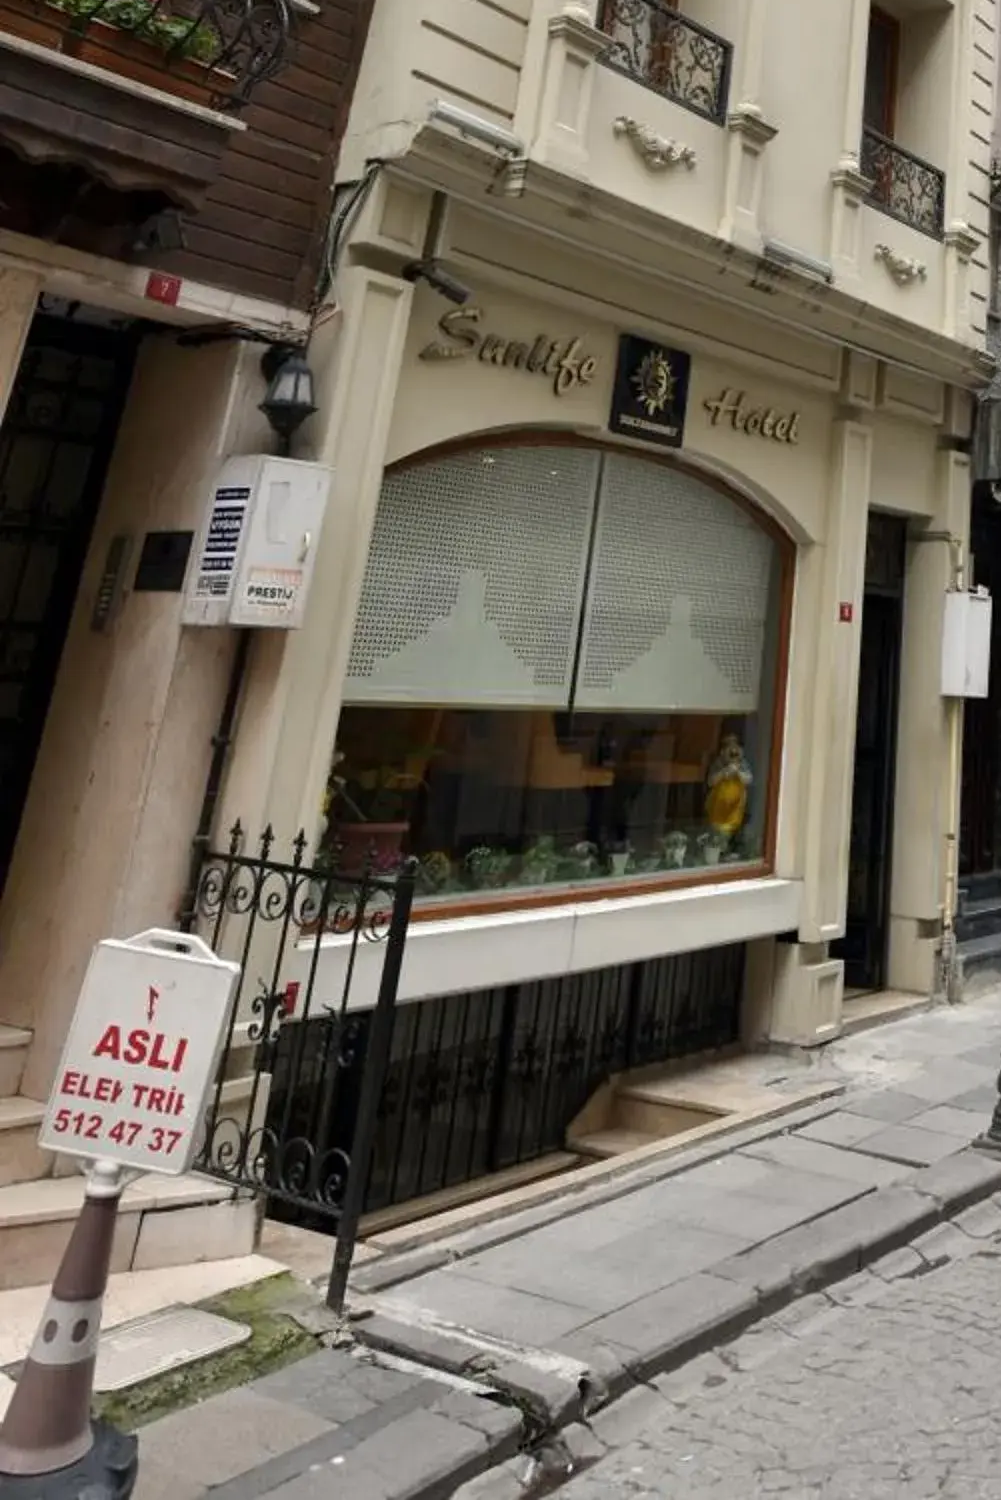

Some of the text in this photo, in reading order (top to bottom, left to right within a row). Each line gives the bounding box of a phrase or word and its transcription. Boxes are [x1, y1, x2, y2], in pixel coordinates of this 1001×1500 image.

[418, 306, 799, 445] Sunlife Hotel
[92, 1025, 189, 1073] ASLI
[53, 1108, 183, 1156] 512 47 37
